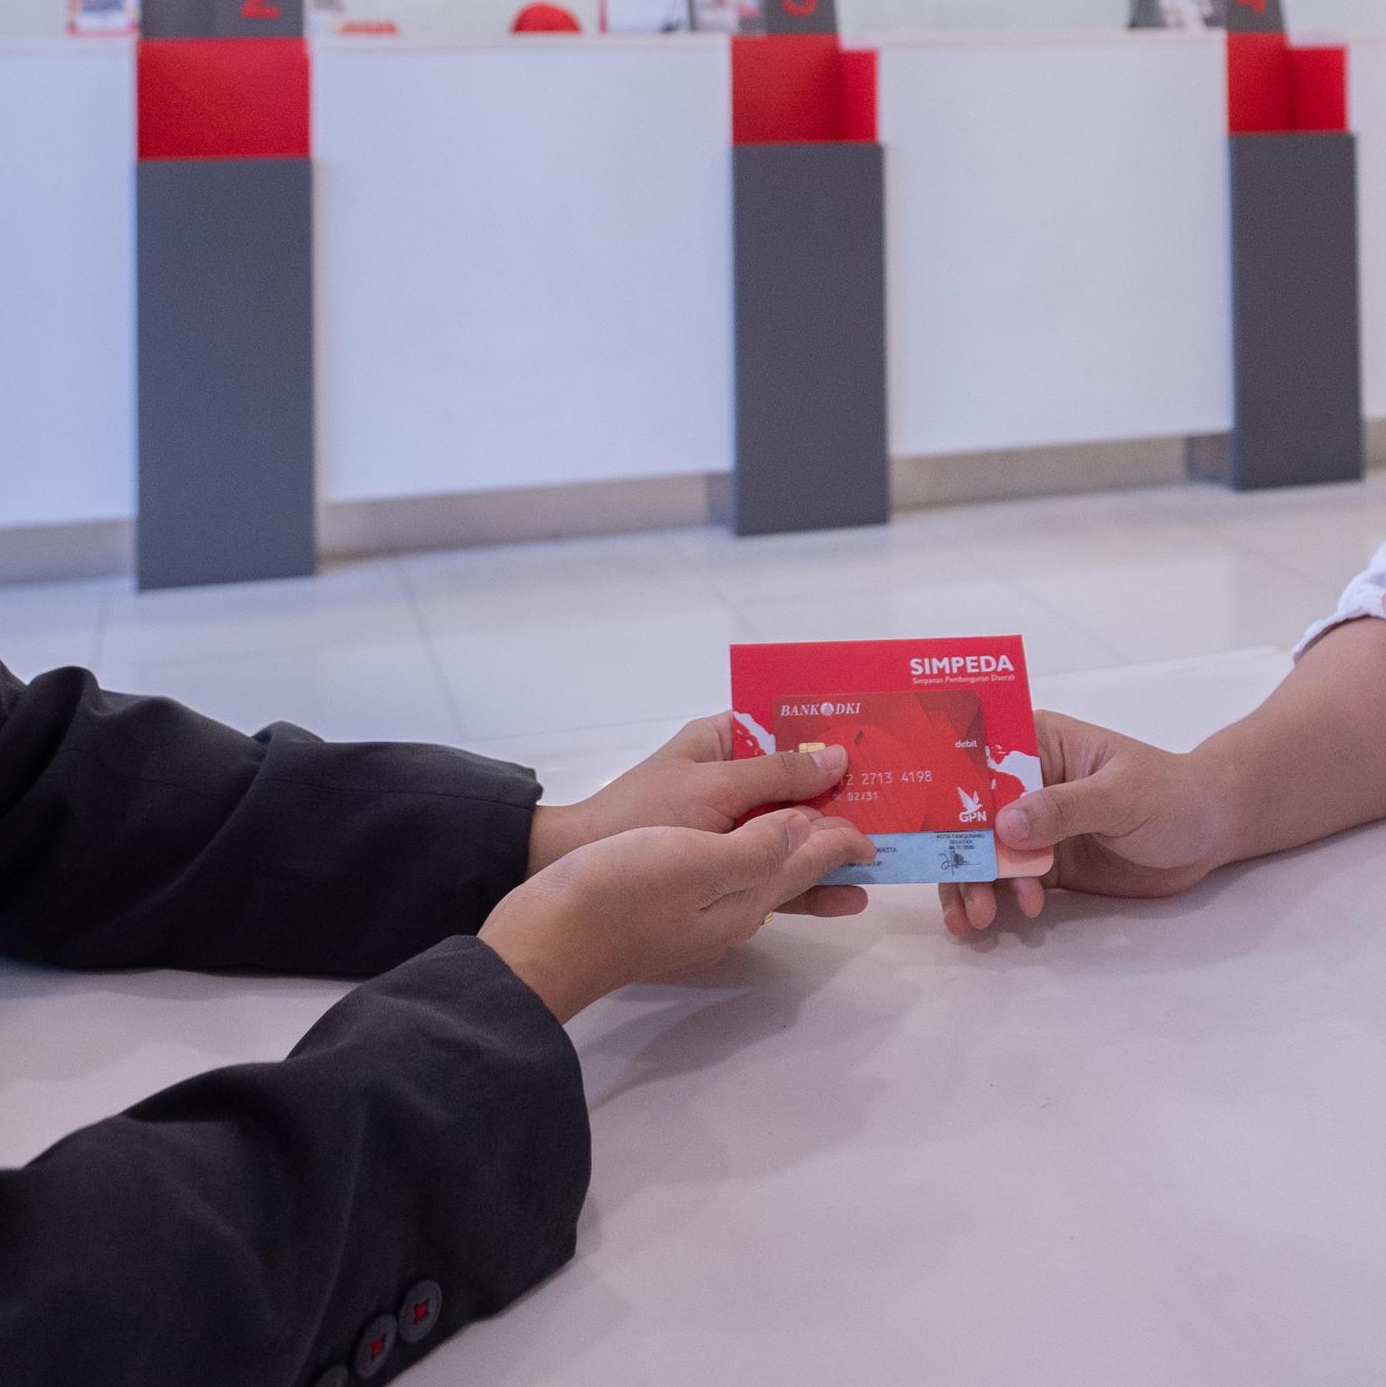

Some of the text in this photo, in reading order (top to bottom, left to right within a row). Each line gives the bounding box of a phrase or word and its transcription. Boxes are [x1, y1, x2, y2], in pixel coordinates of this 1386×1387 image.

[910, 655, 1014, 676] SIMPEDA
[991, 673, 1015, 682] Daerah
[780, 702, 861, 716] BANK DKI
[955, 740, 978, 748] debit
[861, 773, 893, 785] 2713
[901, 770, 933, 783] 4198
[847, 792, 878, 801] 02/31
[959, 810, 988, 822] GPN
